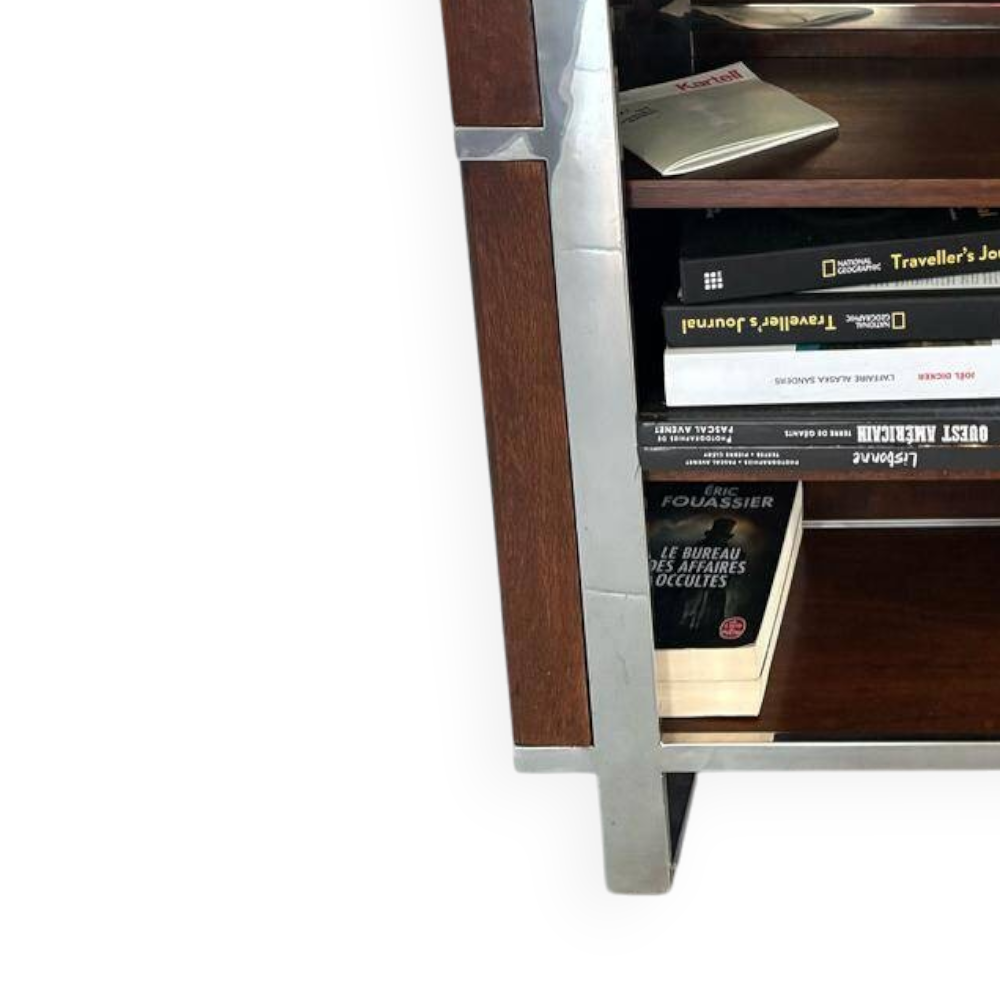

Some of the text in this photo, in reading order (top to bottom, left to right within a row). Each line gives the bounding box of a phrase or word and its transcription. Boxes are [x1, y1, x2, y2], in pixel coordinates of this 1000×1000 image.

[675, 69, 743, 92] Kartell
[837, 257, 872, 268] NATIONAL
[890, 242, 976, 270] Traveller's
[837, 262, 882, 275] GEOGRAPHIC
[681, 313, 837, 335] Traveller's Journal
[845, 312, 891, 323] GEOGRAPHIC
[855, 319, 891, 330] NATIONAL
[774, 373, 896, 386] L'AFFAIRE ALASKA SANDERS
[918, 370, 976, 382] JOËL DICKER
[654, 425, 735, 434] PASCAL AVENET
[784, 429, 852, 440] TERRE DE GÉANTS
[856, 424, 989, 447] OUEST AMÉRICAIN
[852, 449, 918, 469] Lisbonne
[704, 484, 739, 497] ÉRIC
[661, 495, 775, 509] FOUASSIER
[661, 546, 741, 561] LE BUREAU
[677, 560, 747, 575] AFFAIRES
[655, 574, 728, 589] OCCULTES
